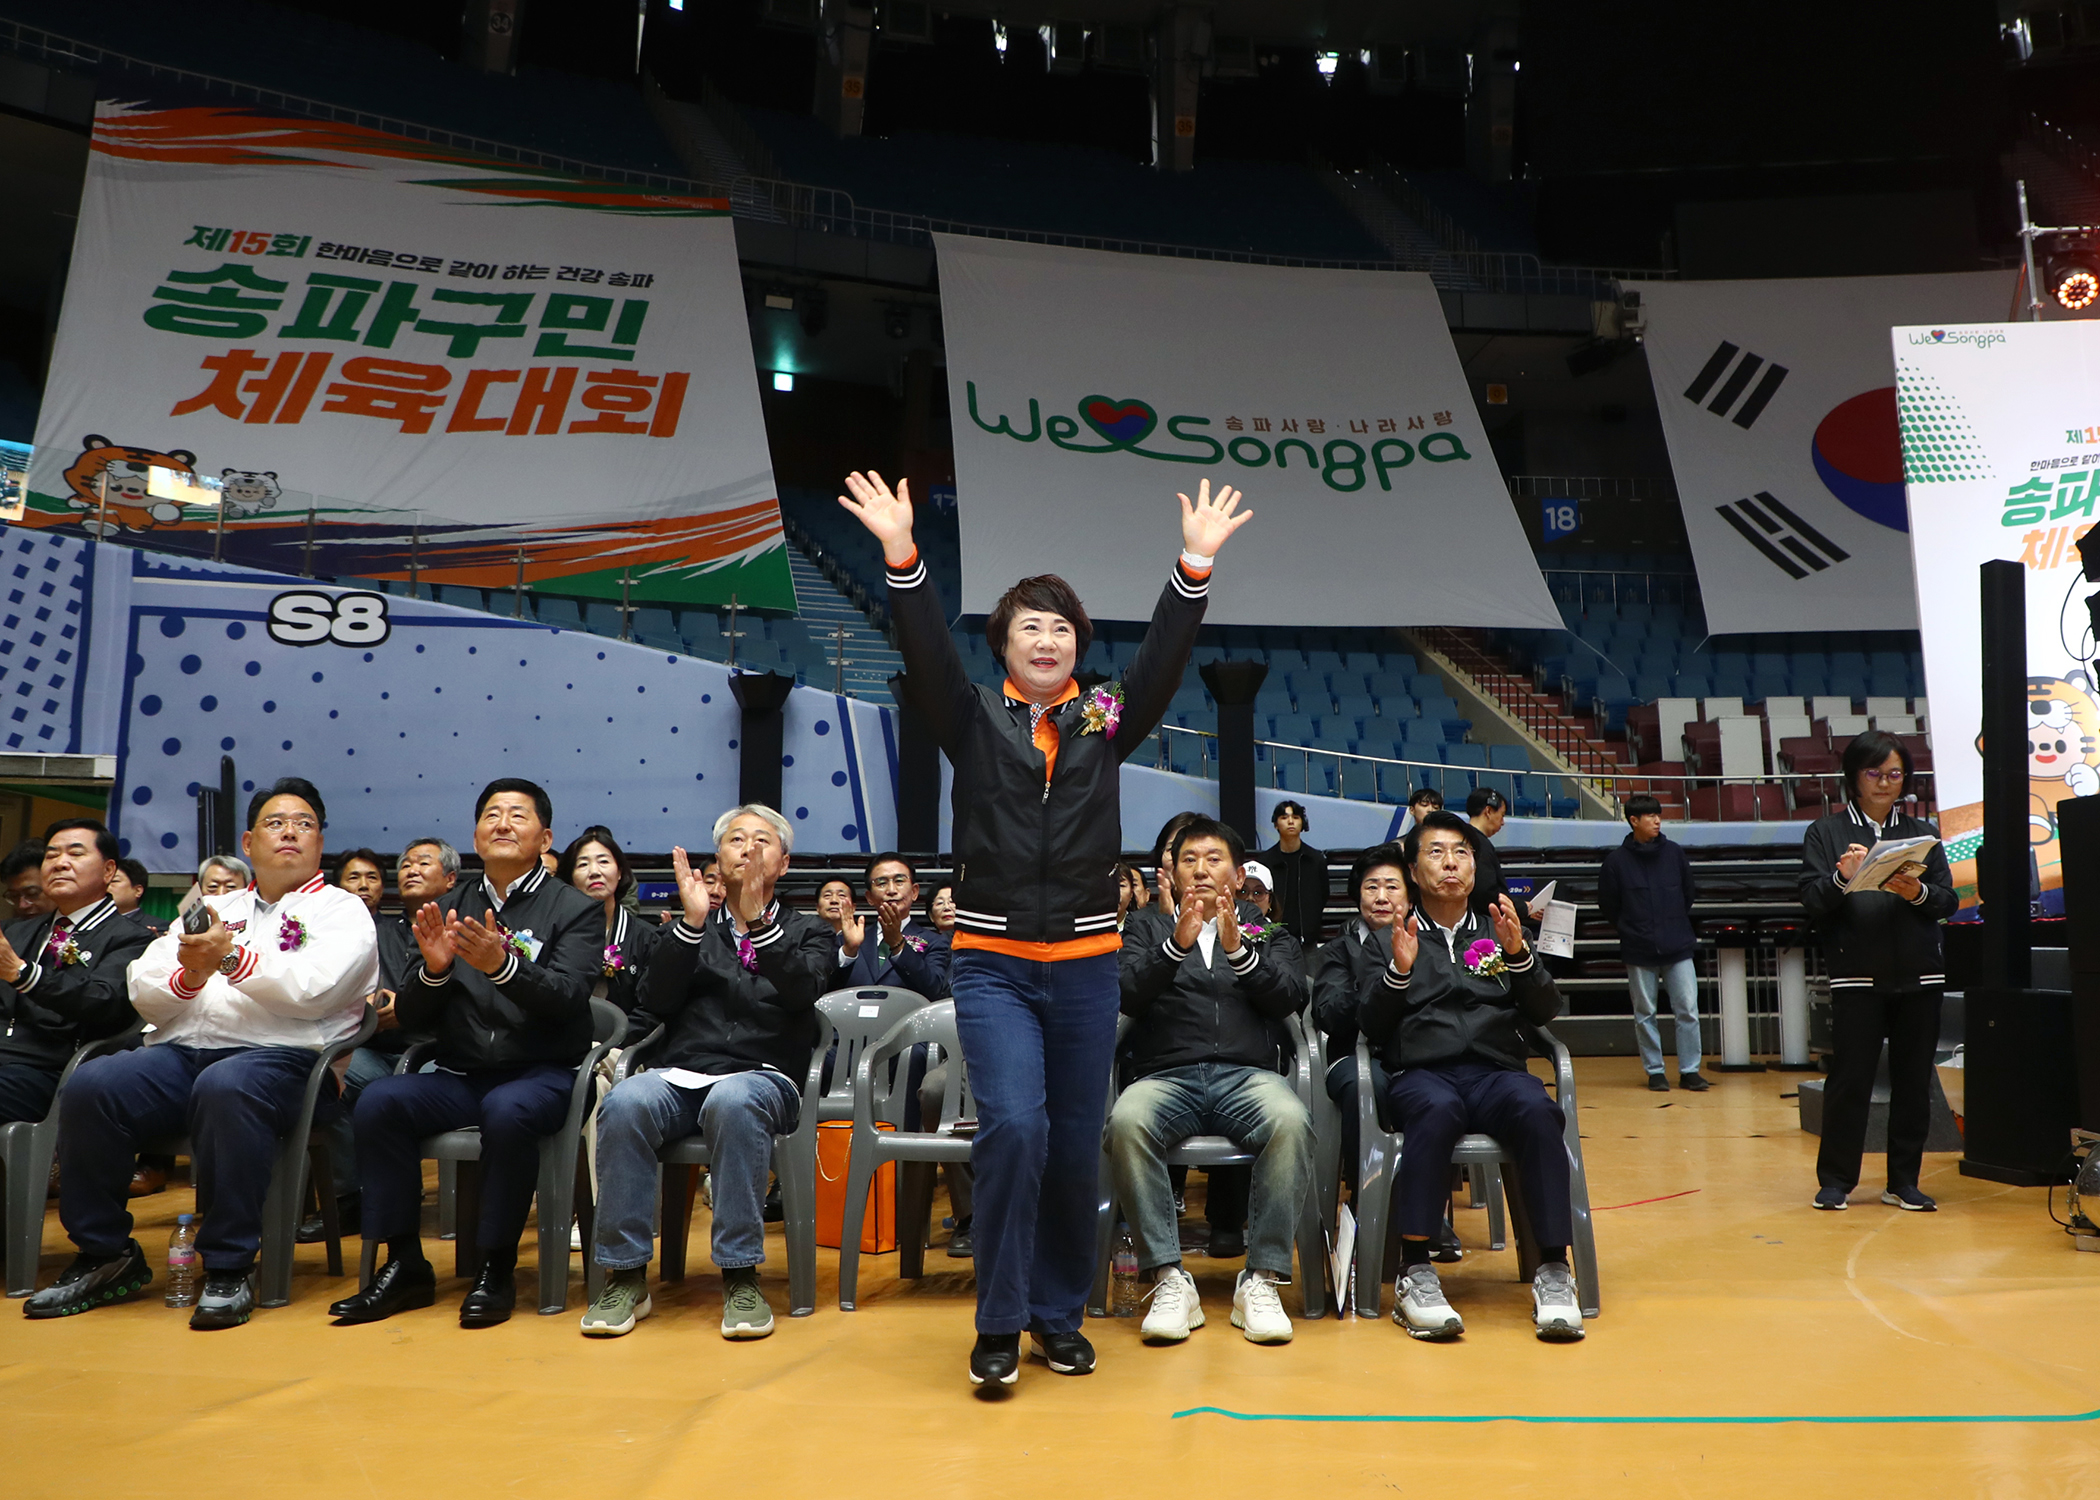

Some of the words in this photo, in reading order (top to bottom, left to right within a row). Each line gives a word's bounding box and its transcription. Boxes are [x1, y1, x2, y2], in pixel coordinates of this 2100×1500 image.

[184, 225, 312, 260] 제15회
[315, 241, 444, 274] 한마음으로
[446, 260, 498, 281] 같이
[501, 264, 551, 281] 하는
[555, 264, 606, 285] 건강
[607, 271, 655, 289] 송파
[143, 262, 648, 364] 송파구민
[1908, 333, 1934, 346] We
[1947, 331, 2006, 349] Songpa
[170, 348, 691, 439] 체육대회
[966, 380, 1082, 453] We
[1166, 413, 1472, 493] Songpa
[2066, 426, 2100, 444] 제1
[2030, 456, 2078, 471] 한마음으로
[1545, 505, 1576, 532] 18
[268, 592, 389, 646] S8
